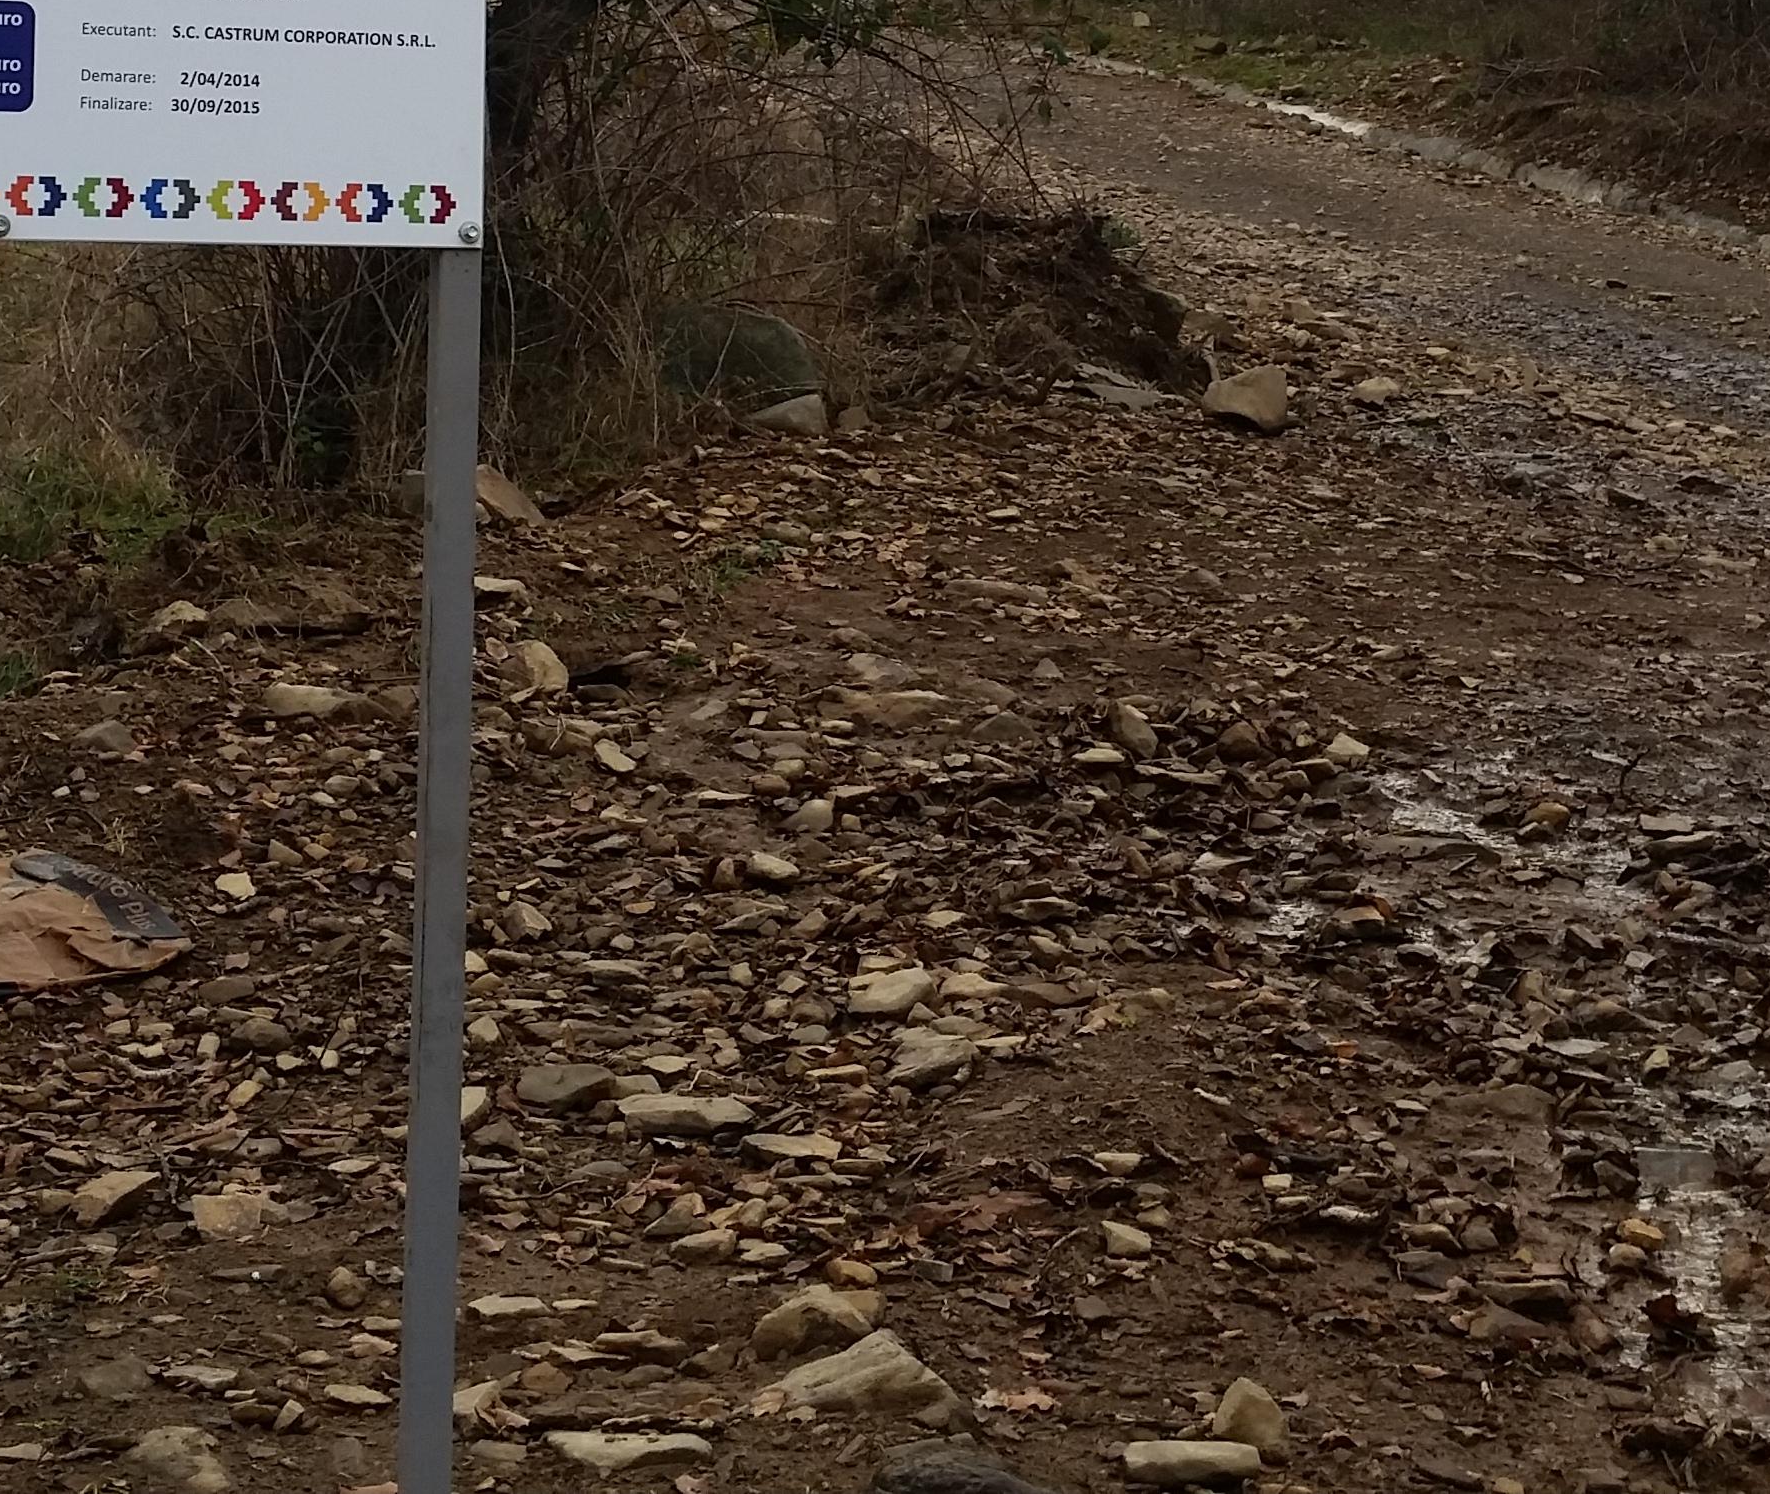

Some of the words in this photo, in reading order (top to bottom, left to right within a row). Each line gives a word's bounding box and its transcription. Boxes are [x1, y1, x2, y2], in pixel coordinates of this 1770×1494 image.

[82, 22, 157, 38] Executant:
[172, 25, 200, 39] S.C.
[204, 26, 279, 42] CASTRUM
[284, 29, 393, 46] CORPORATION
[396, 33, 436, 48] S.R.L.
[81, 68, 156, 84] Demarare:
[180, 70, 261, 89] 2/04/2014
[80, 96, 152, 111] Finalizare:
[170, 97, 260, 116] 30/09/2015
